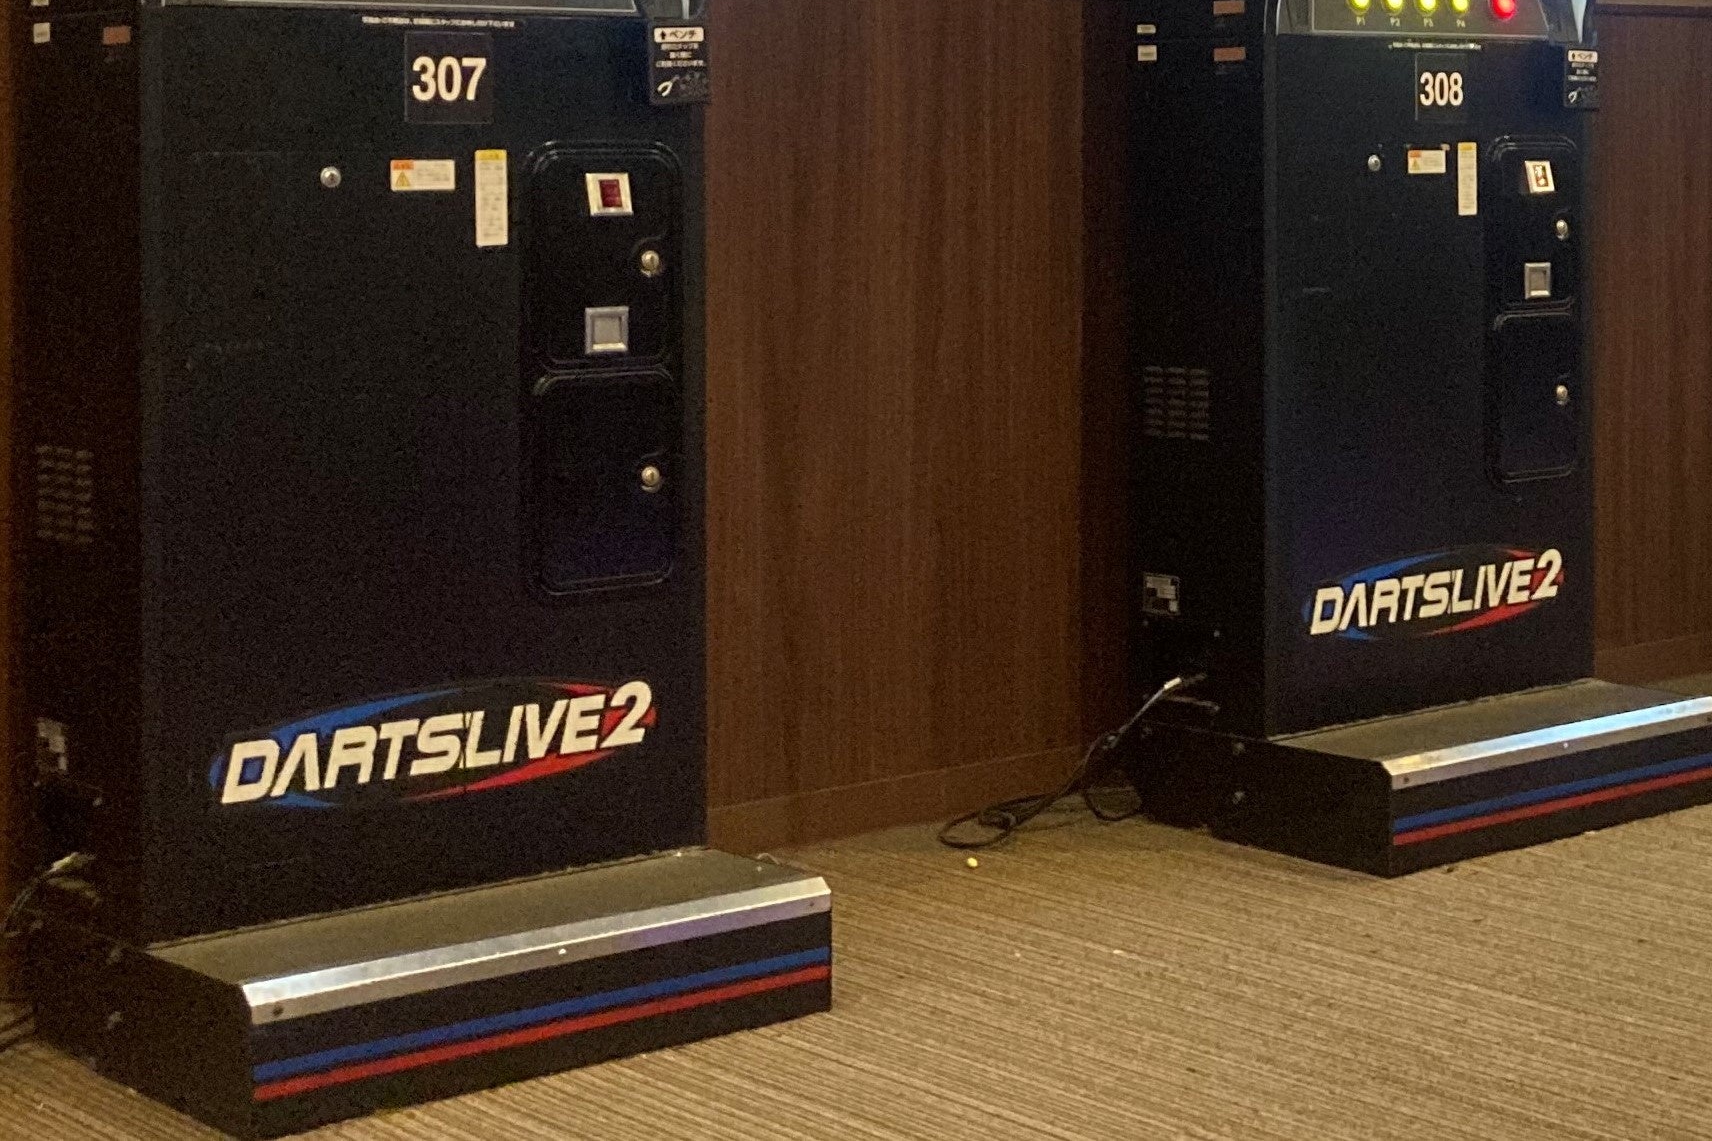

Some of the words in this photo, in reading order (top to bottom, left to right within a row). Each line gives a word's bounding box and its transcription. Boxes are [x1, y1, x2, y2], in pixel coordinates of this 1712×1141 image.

[412, 56, 487, 102] 307
[1419, 71, 1463, 106] 308
[1310, 549, 1562, 636] DARTSLIVE2
[222, 680, 652, 805] DARTSLIVE2
